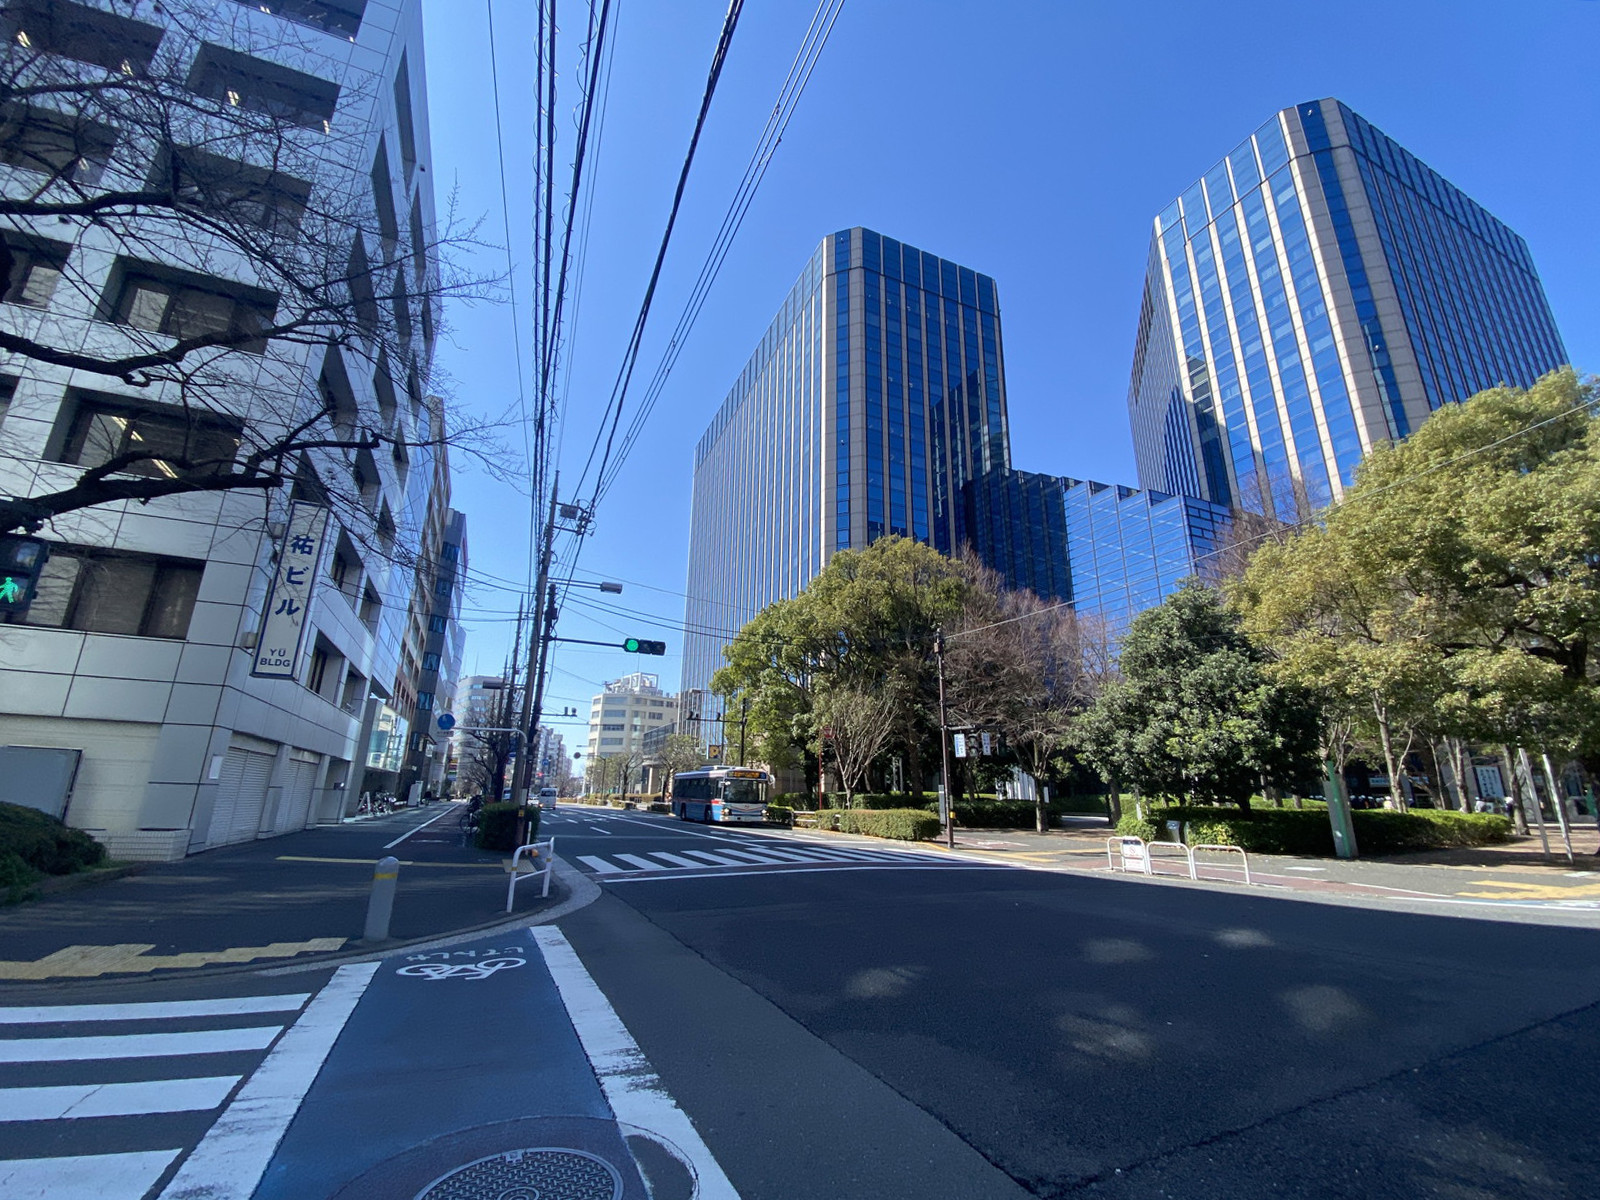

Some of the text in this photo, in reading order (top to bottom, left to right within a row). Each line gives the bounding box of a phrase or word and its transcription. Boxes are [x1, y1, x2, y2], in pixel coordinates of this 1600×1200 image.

[275, 535, 315, 616] 祐ビル
[260, 657, 291, 668] BLDG
